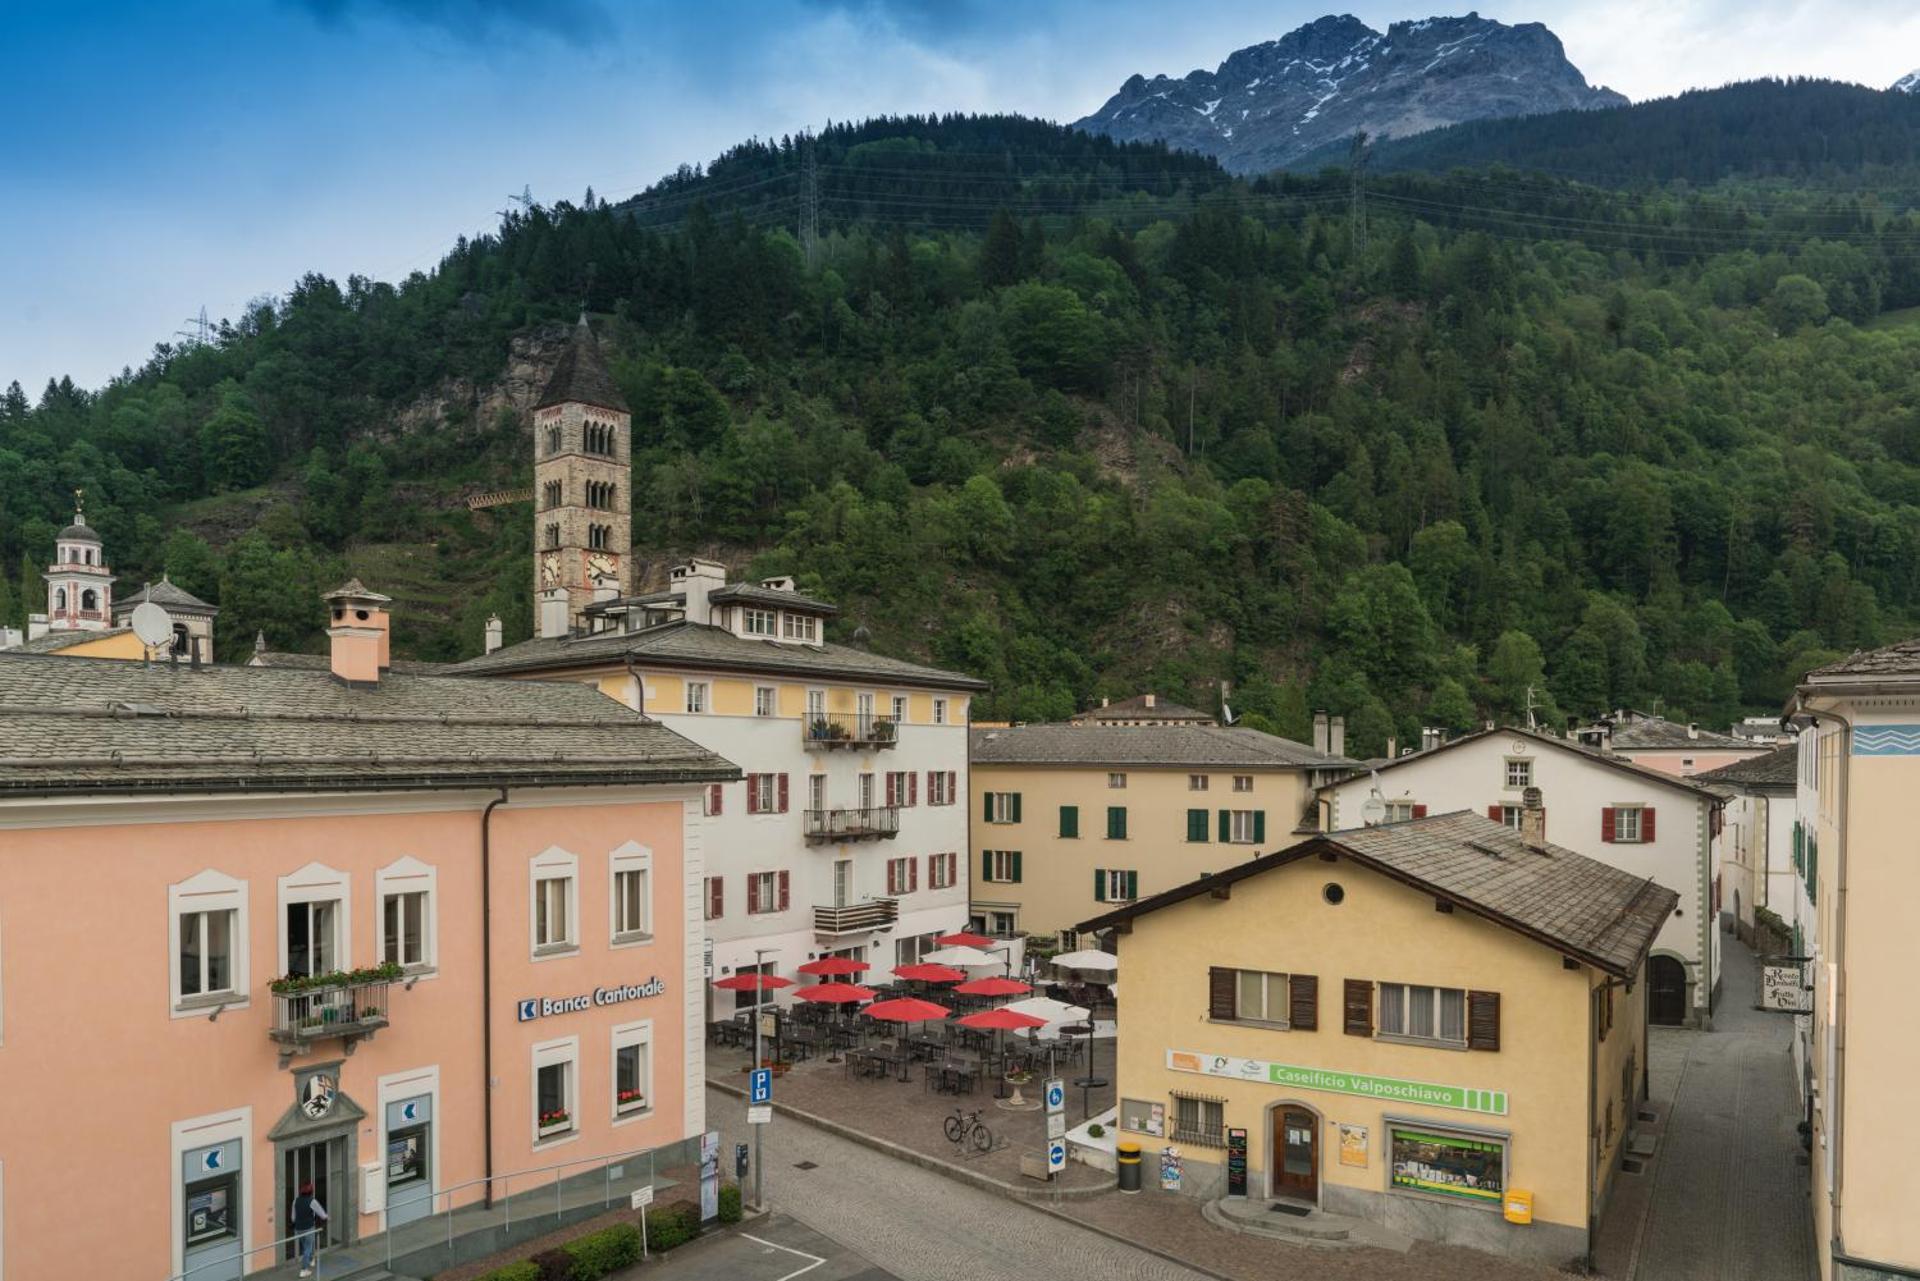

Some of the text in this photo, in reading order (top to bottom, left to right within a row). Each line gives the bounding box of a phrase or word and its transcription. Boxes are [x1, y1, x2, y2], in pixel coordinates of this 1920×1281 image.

[542, 977, 665, 1016] Banca Cantonale
[757, 1072, 766, 1089] P
[1277, 1068, 1452, 1102] Caseificio Valposchiavo
